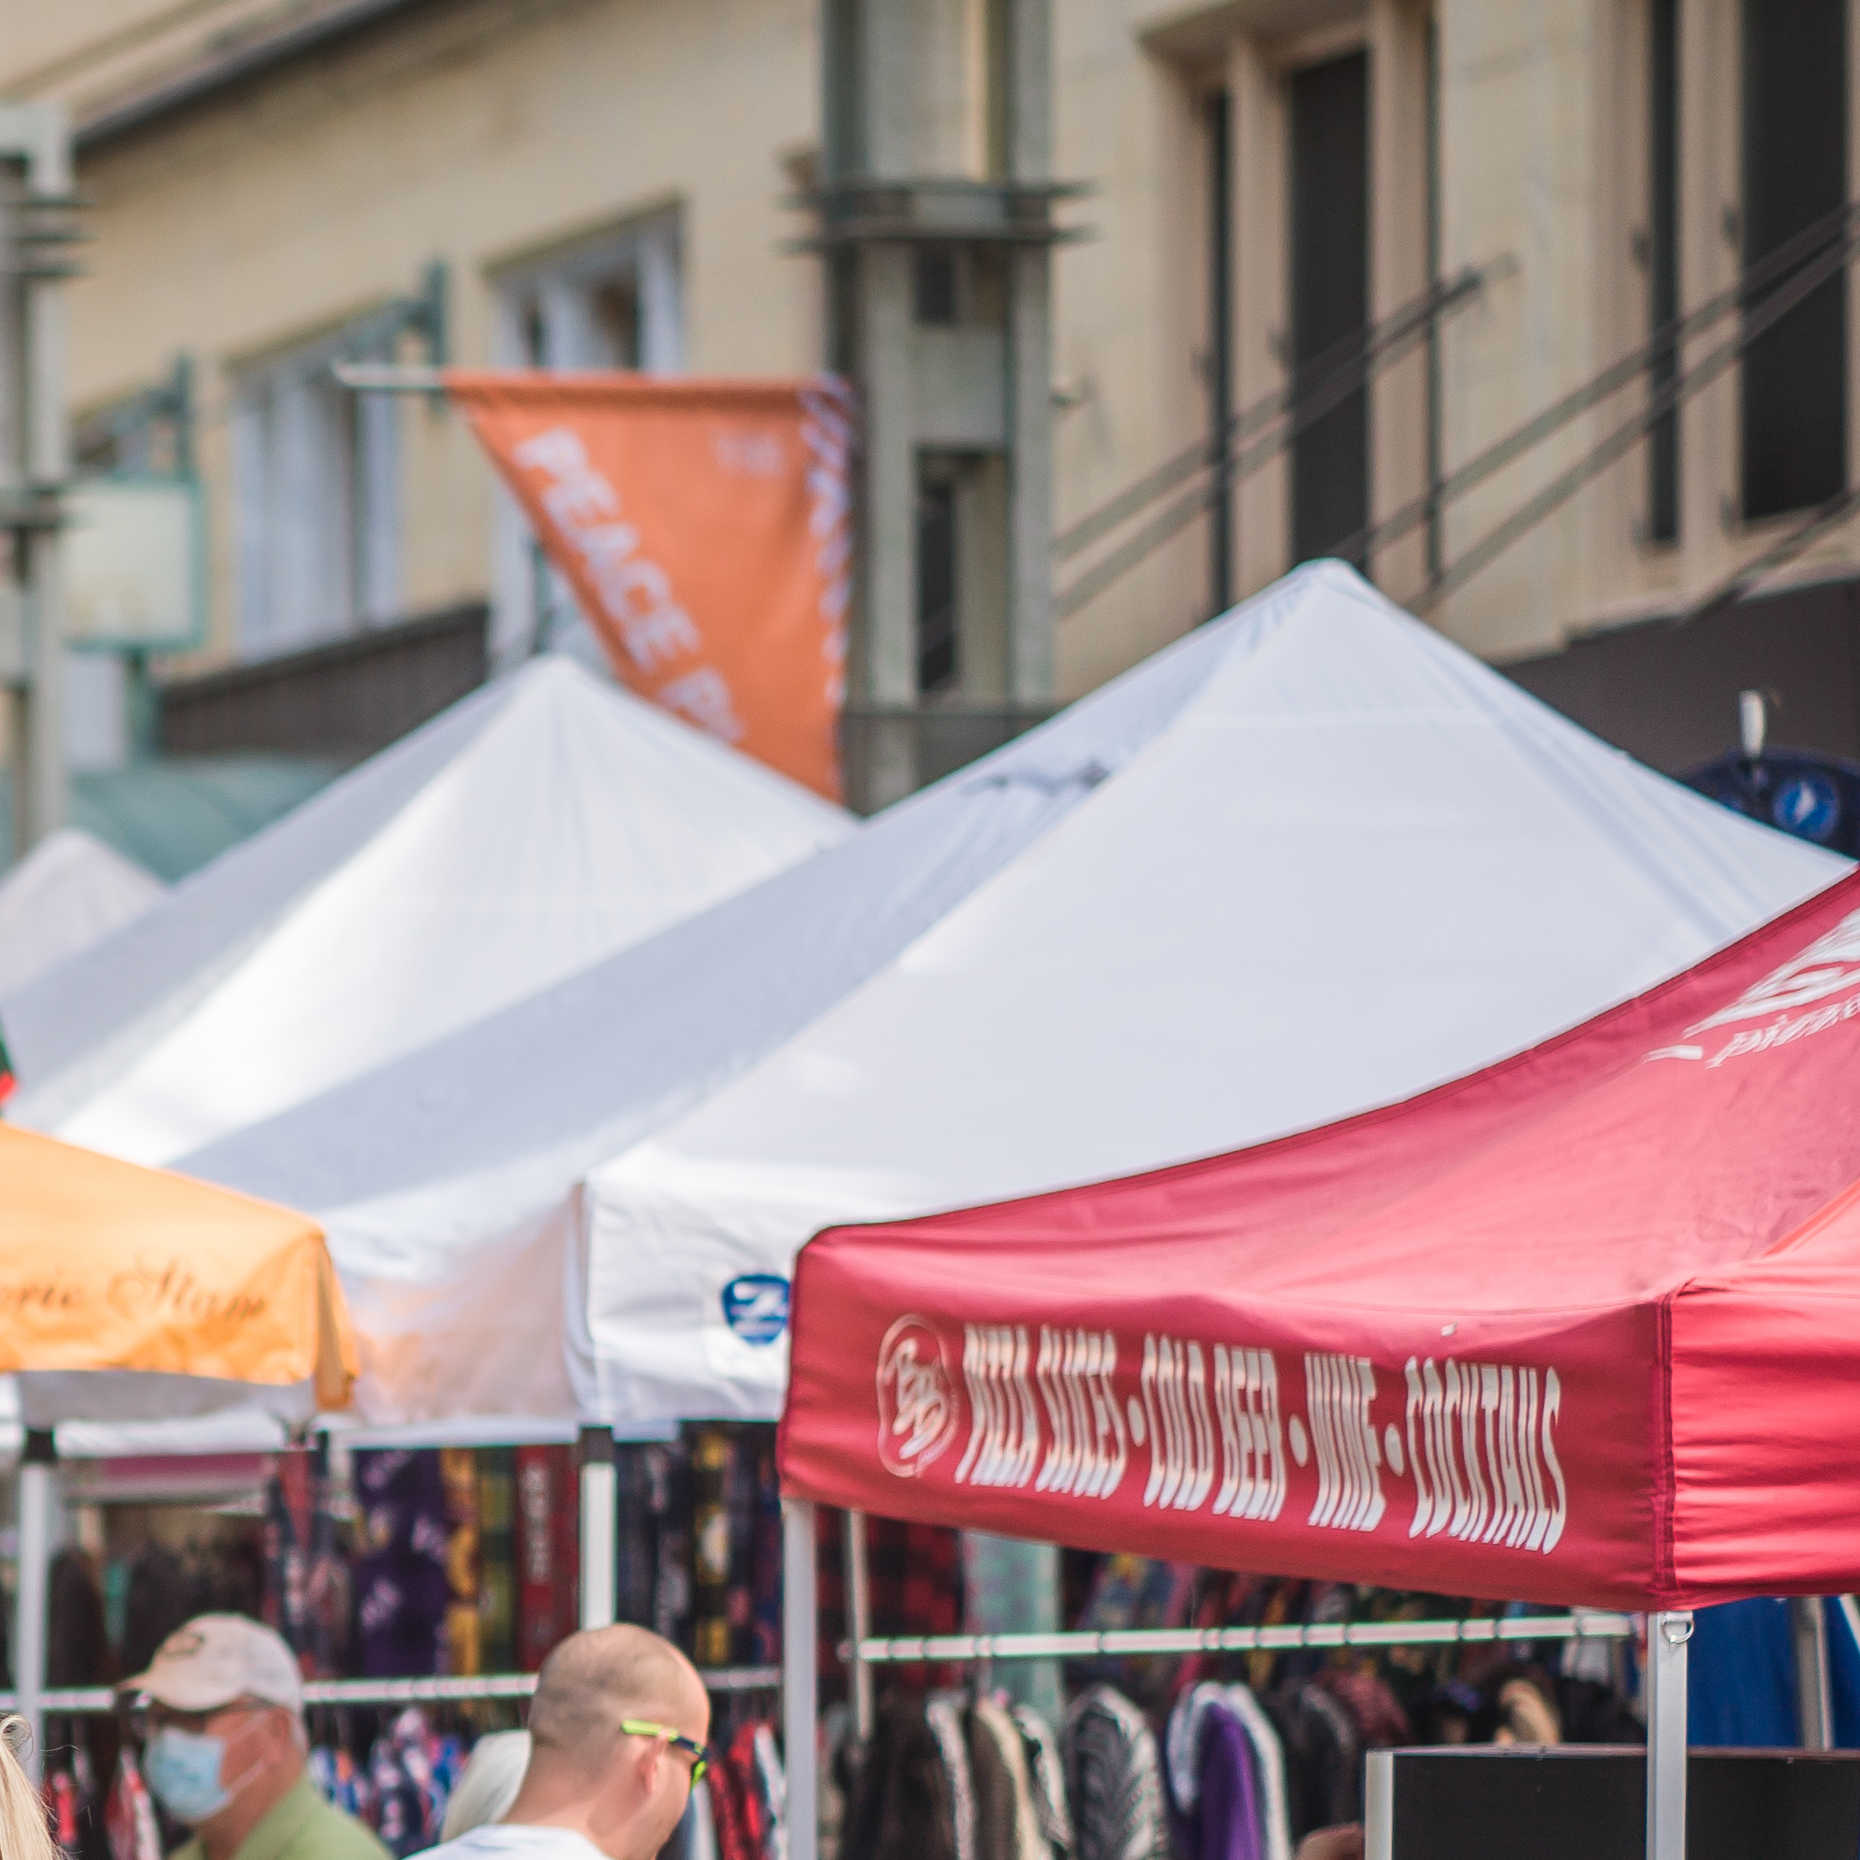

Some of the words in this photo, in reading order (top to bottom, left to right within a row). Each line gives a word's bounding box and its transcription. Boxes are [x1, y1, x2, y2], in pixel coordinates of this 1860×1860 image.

[511, 428, 701, 676] PEACE
[954, 1322, 1041, 1489] PIZZA
[1035, 1322, 1128, 1501] SLICES
[1141, 1330, 1215, 1512] COLD
[1212, 1342, 1287, 1523] BEER
[1304, 1350, 1387, 1532] WINE
[1404, 1354, 1567, 1556] COCKTAILS
